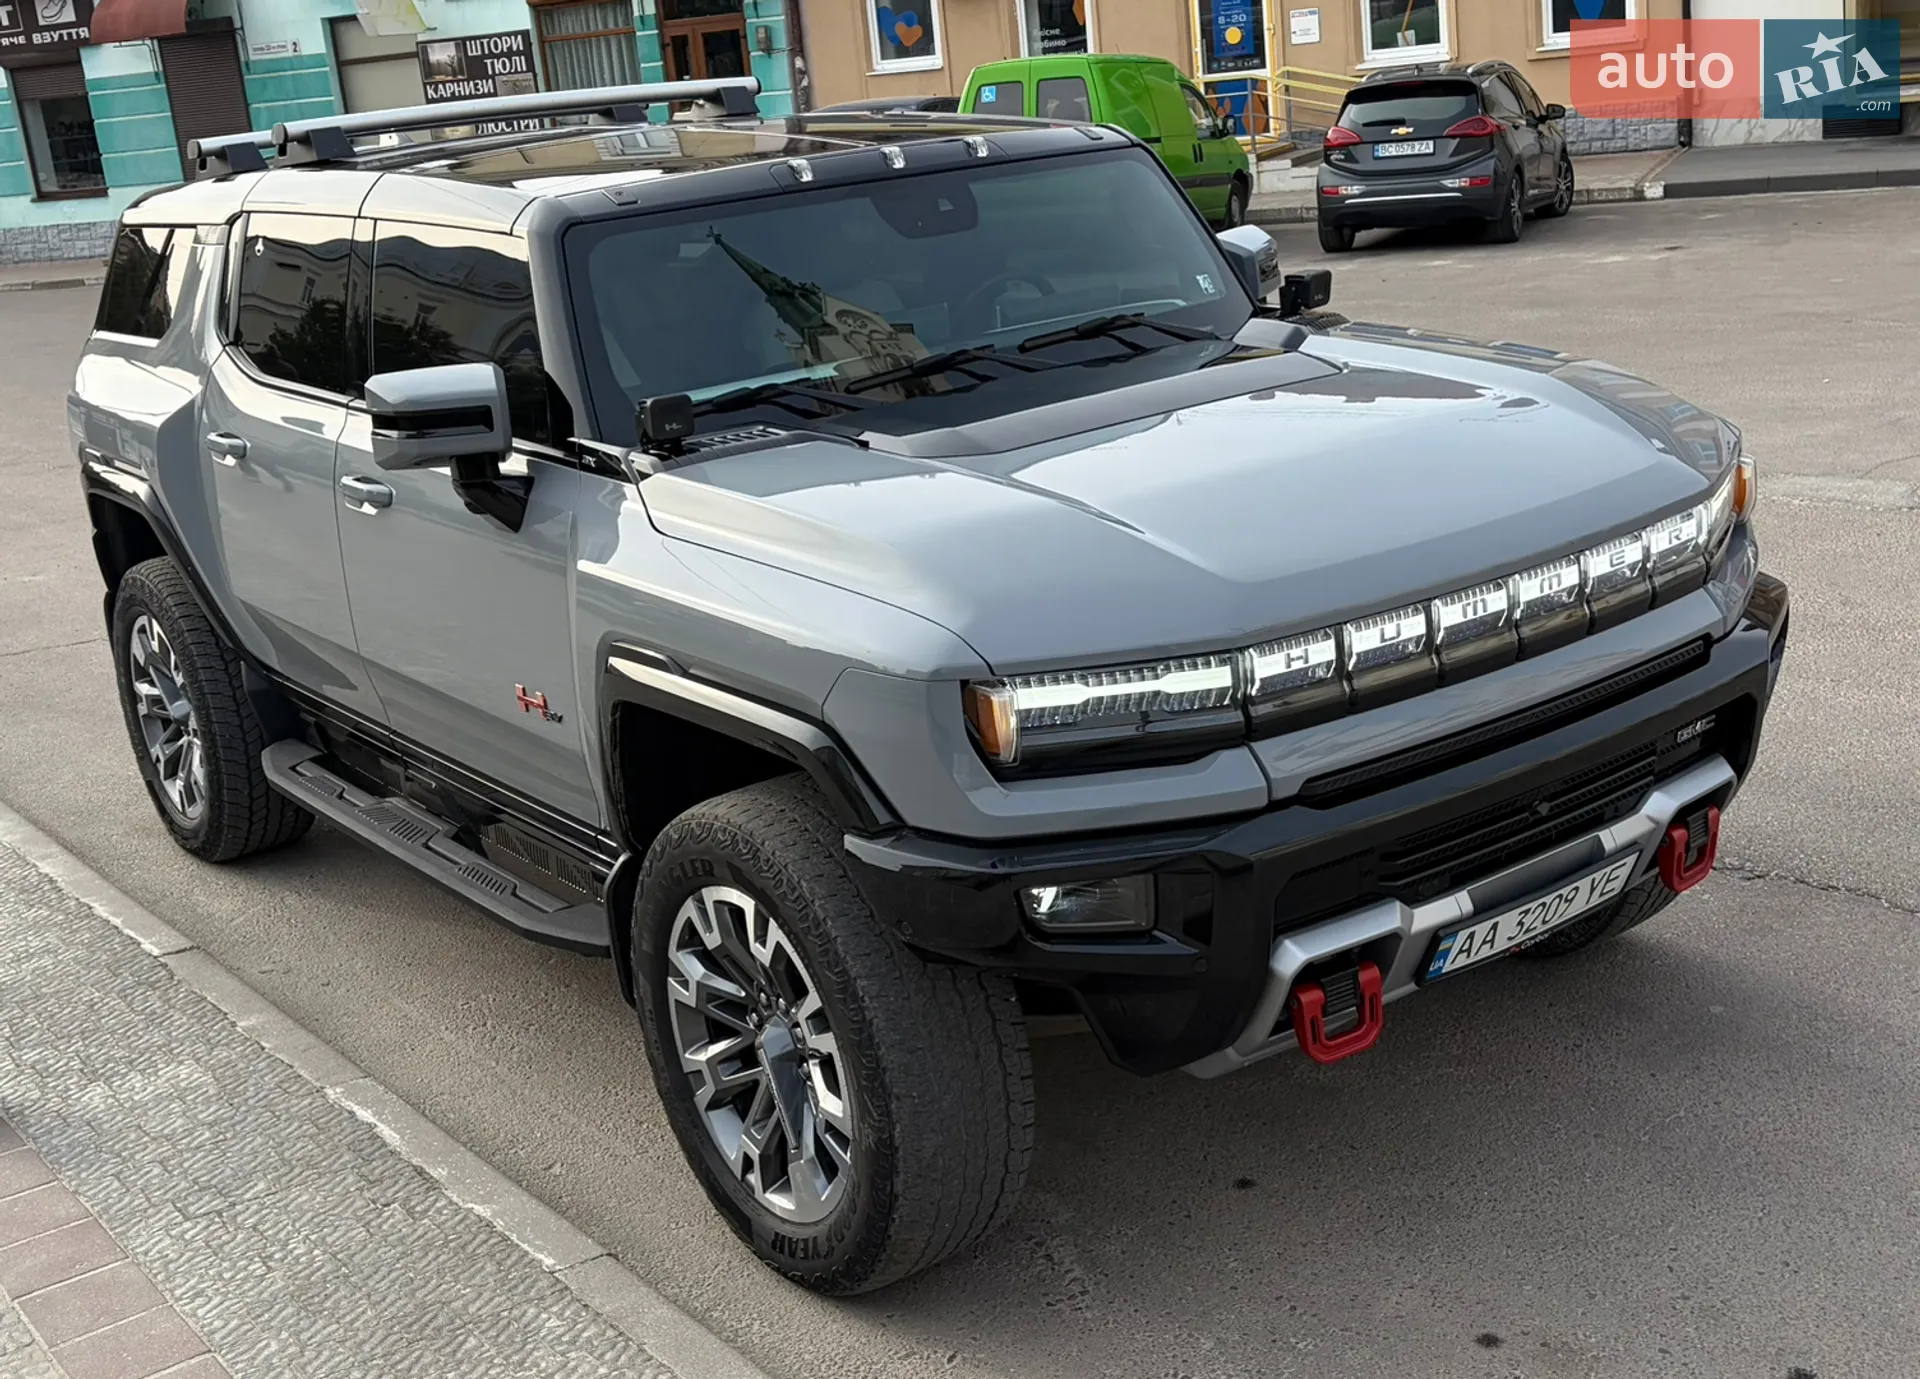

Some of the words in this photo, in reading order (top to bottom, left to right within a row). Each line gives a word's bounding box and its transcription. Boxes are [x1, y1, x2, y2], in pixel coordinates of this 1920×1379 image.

[1218, 14, 1247, 24] 8-20
[32, 27, 89, 44] ВЗУТТЯ
[292, 41, 298, 53] 2
[465, 34, 523, 56] ШТОРИ
[484, 55, 527, 75] ТЮЛІ
[426, 79, 494, 99] КАРНИЗИ
[478, 119, 540, 135] ЛЮСТРИ
[1381, 145, 1394, 155] BC
[1417, 142, 1431, 152] ZA
[1677, 714, 1716, 743] GMC
[1451, 921, 1499, 964] AA
[1507, 886, 1580, 941] 3209
[1585, 862, 1627, 905] YE
[1429, 958, 1444, 971] UA
